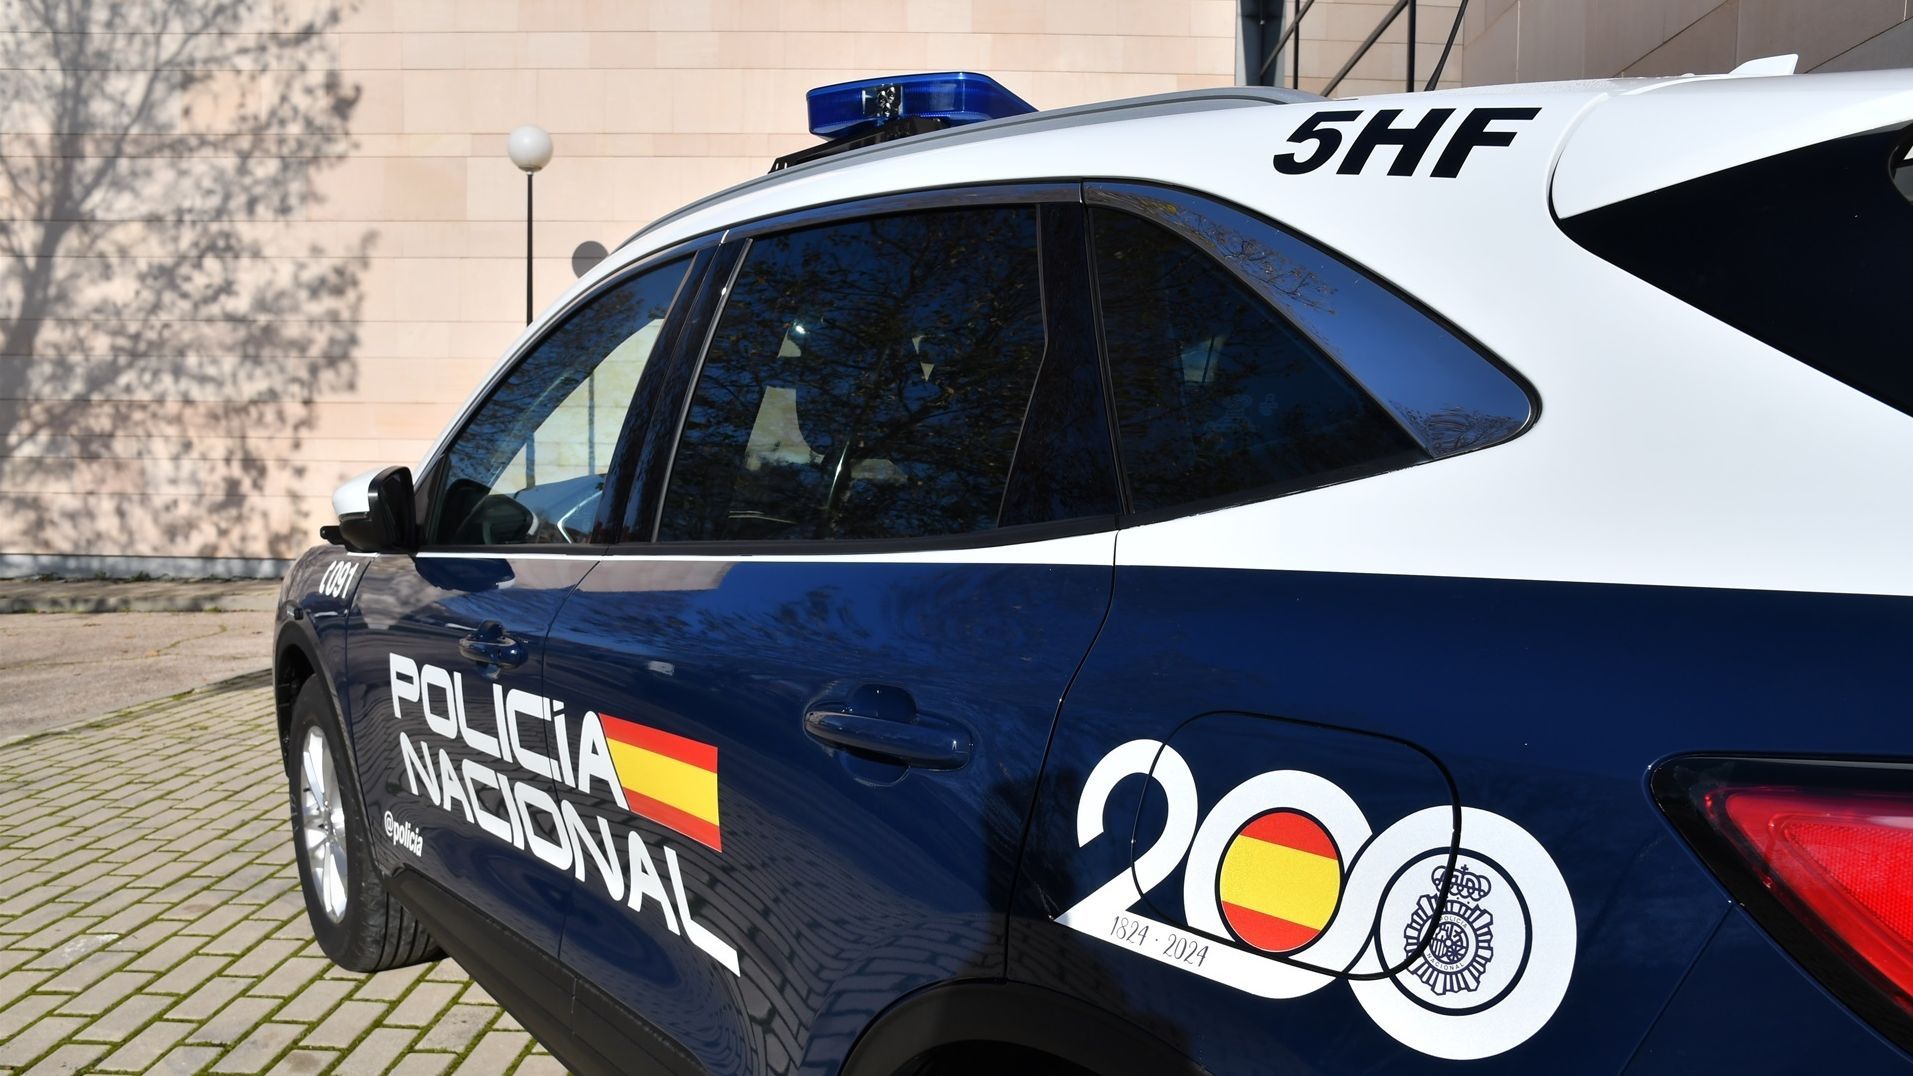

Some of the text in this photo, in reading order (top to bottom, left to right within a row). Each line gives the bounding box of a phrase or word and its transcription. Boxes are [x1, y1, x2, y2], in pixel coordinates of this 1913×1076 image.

[1272, 107, 1543, 179] 5HF
[325, 560, 360, 599] 091
[384, 810, 423, 857] @policia
[399, 731, 741, 978] NACIONAL
[1053, 738, 1578, 1061] 200
[1110, 915, 1209, 967] 1824 2024
[1426, 953, 1464, 971] NACIONAL
